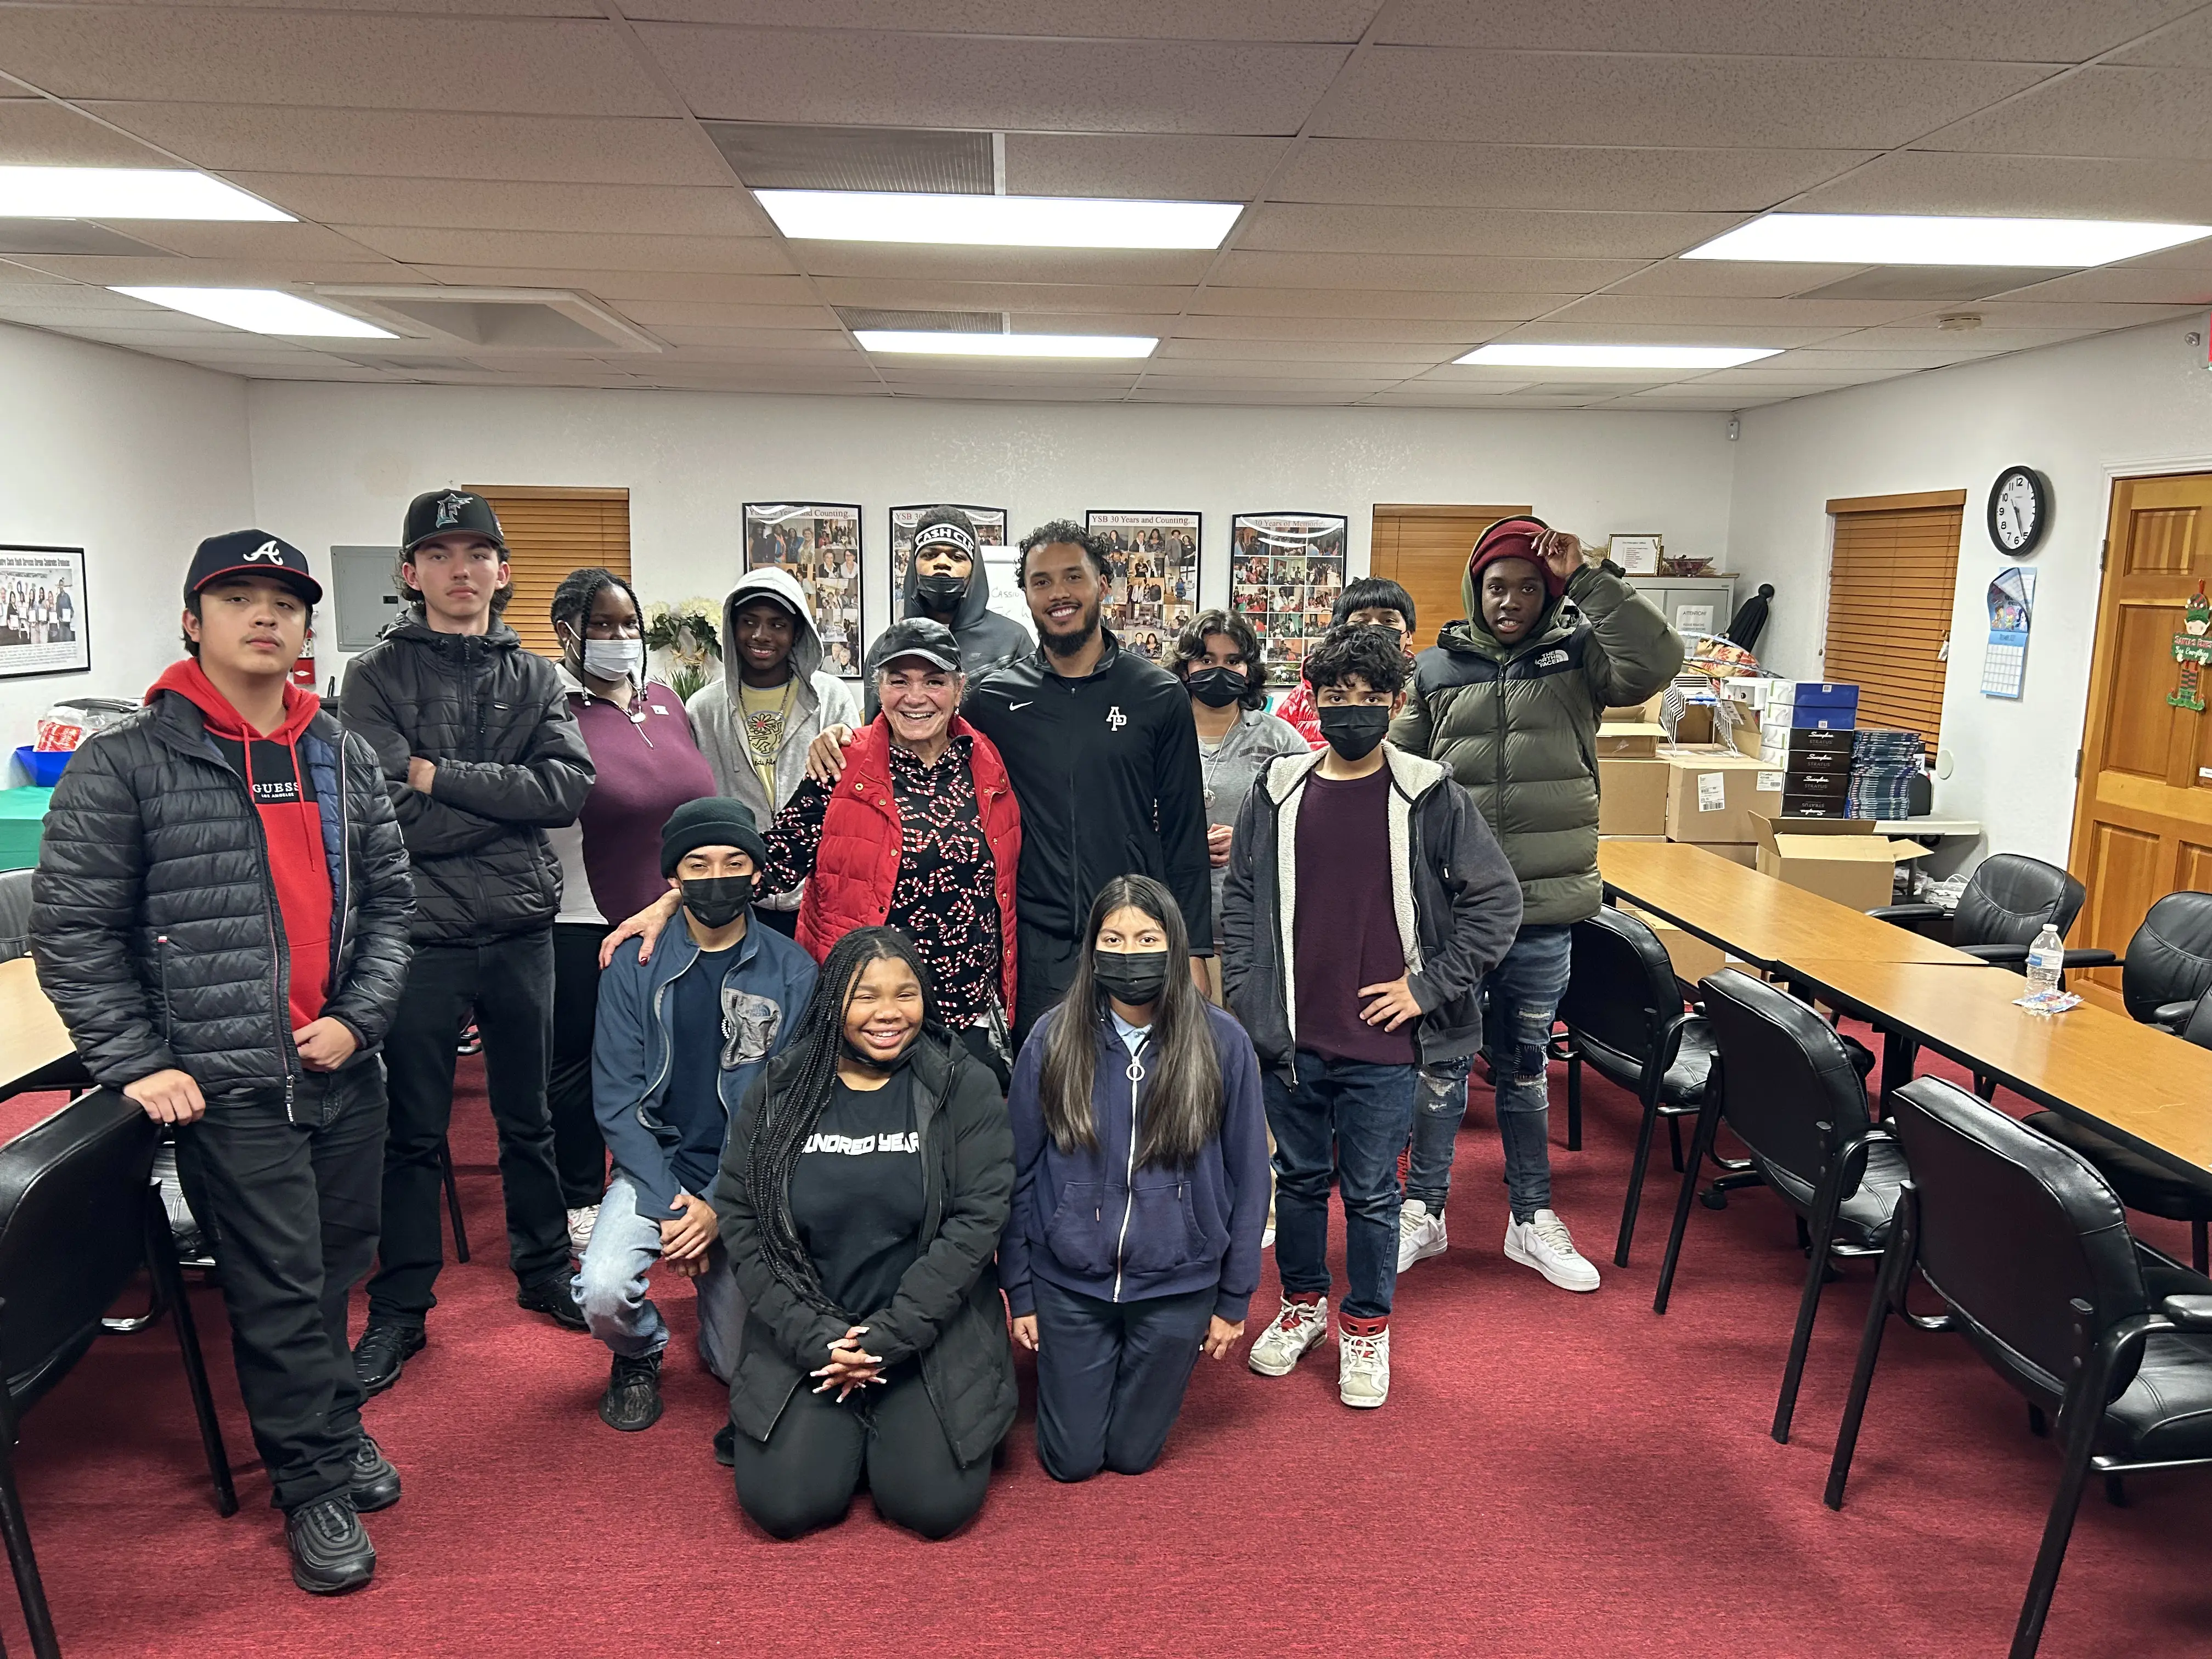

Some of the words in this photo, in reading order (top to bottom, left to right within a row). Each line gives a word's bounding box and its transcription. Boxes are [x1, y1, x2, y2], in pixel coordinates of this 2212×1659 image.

[2009, 482, 2013, 491] 11
[2016, 478, 2023, 486] 12
[2002, 493, 2008, 501] 10
[916, 528, 951, 546] CASH
[2007, 532, 2011, 540] 7
[243, 540, 284, 566] A
[1540, 659, 1557, 668] FACE
[1106, 706, 1127, 731] AP
[252, 782, 299, 793] GUESS
